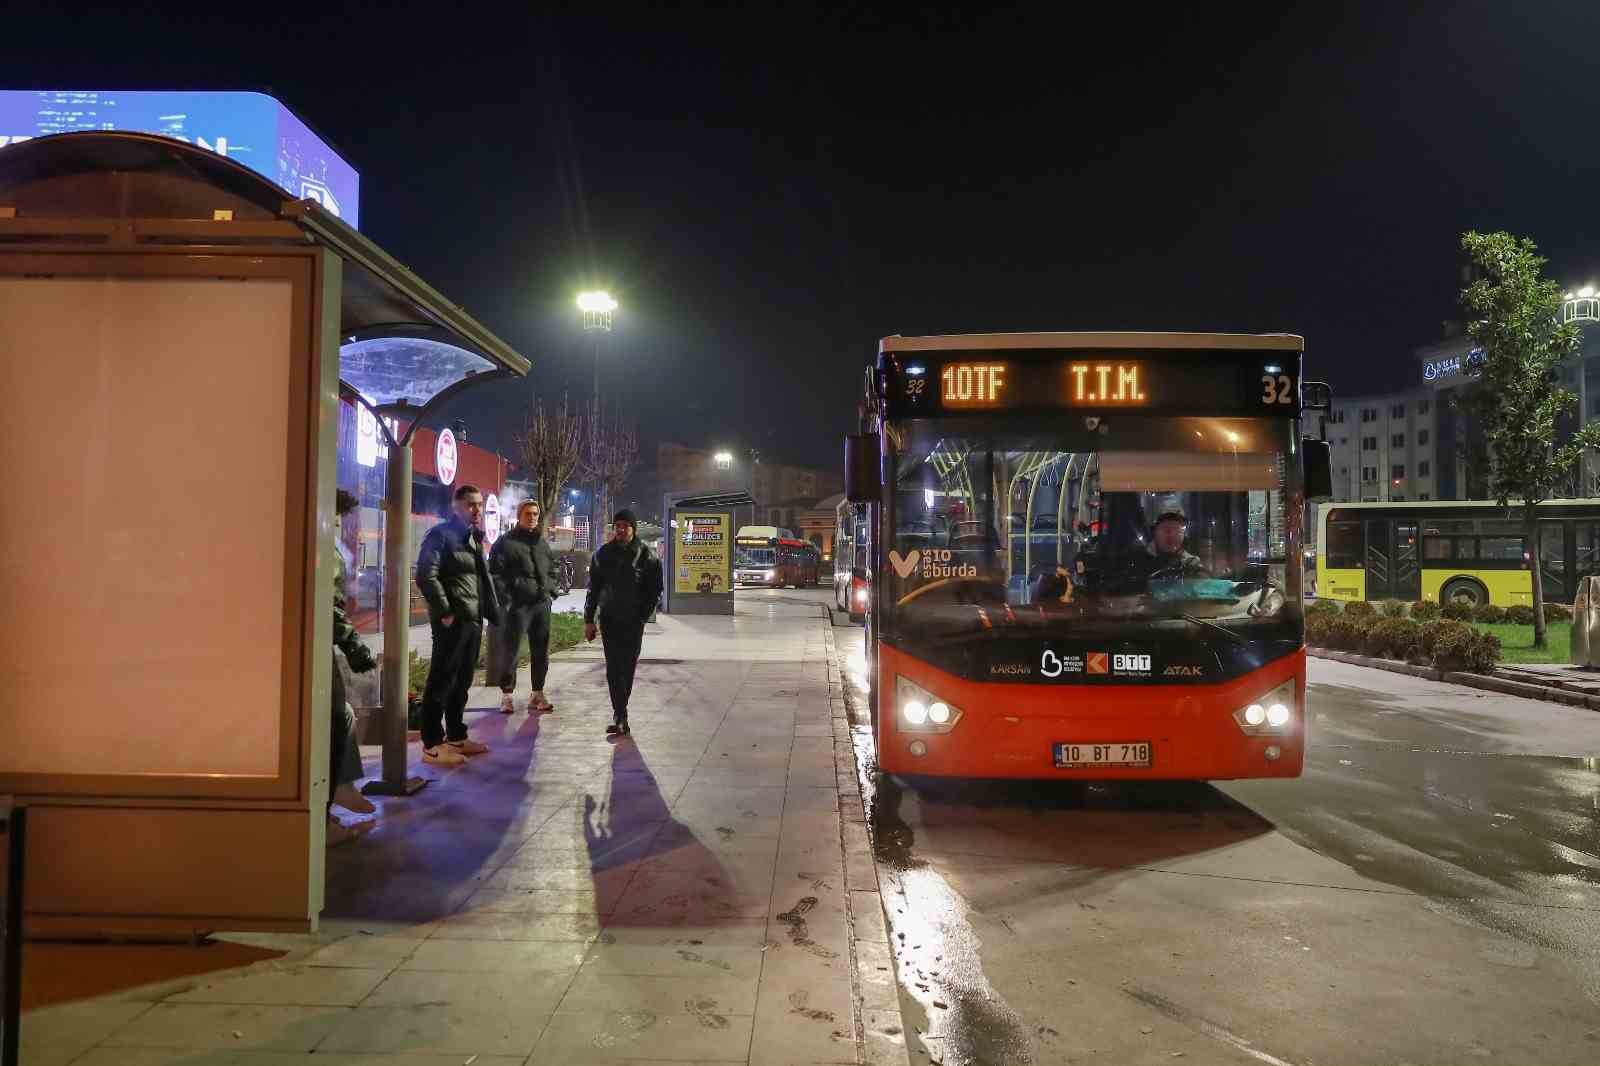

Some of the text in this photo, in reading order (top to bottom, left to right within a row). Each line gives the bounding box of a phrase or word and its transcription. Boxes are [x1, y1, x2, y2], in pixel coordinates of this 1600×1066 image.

[906, 379, 924, 394] 32
[943, 366, 1144, 400] 10TF T.T.M.
[1262, 375, 1291, 404] 32
[991, 663, 1031, 674] KARSAN
[1115, 655, 1149, 669] BTT
[1163, 665, 1202, 675] ATAK
[1064, 745, 1147, 761] 10 BT 718
